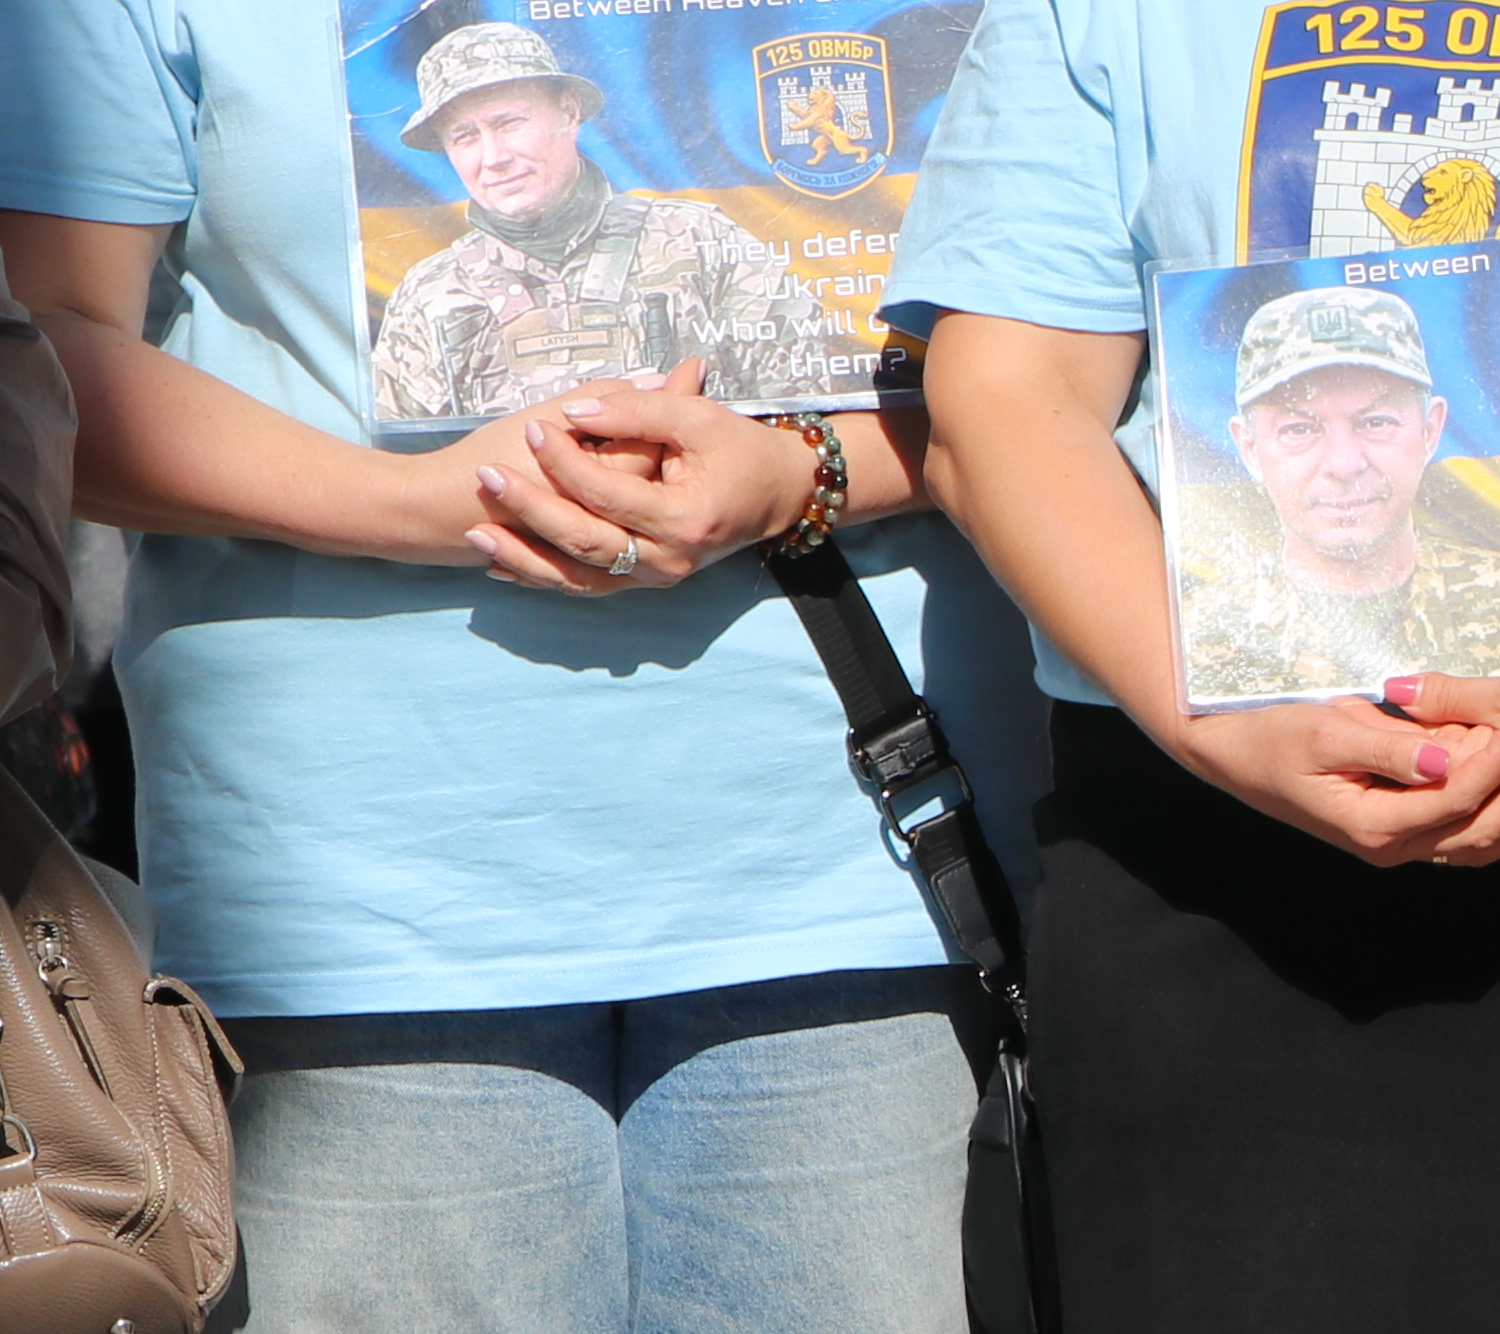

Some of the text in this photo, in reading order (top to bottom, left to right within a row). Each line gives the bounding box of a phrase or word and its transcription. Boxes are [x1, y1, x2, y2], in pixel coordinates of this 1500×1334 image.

[1304, 6, 1426, 56] 125
[766, 39, 874, 67] 125 ОВМБр
[695, 229, 899, 266] They defe
[1344, 249, 1491, 286] Between
[765, 269, 887, 300] Ukrain
[541, 334, 579, 347] LATYSH
[692, 317, 776, 344] Who
[792, 310, 855, 337] will
[789, 347, 906, 378] them?
